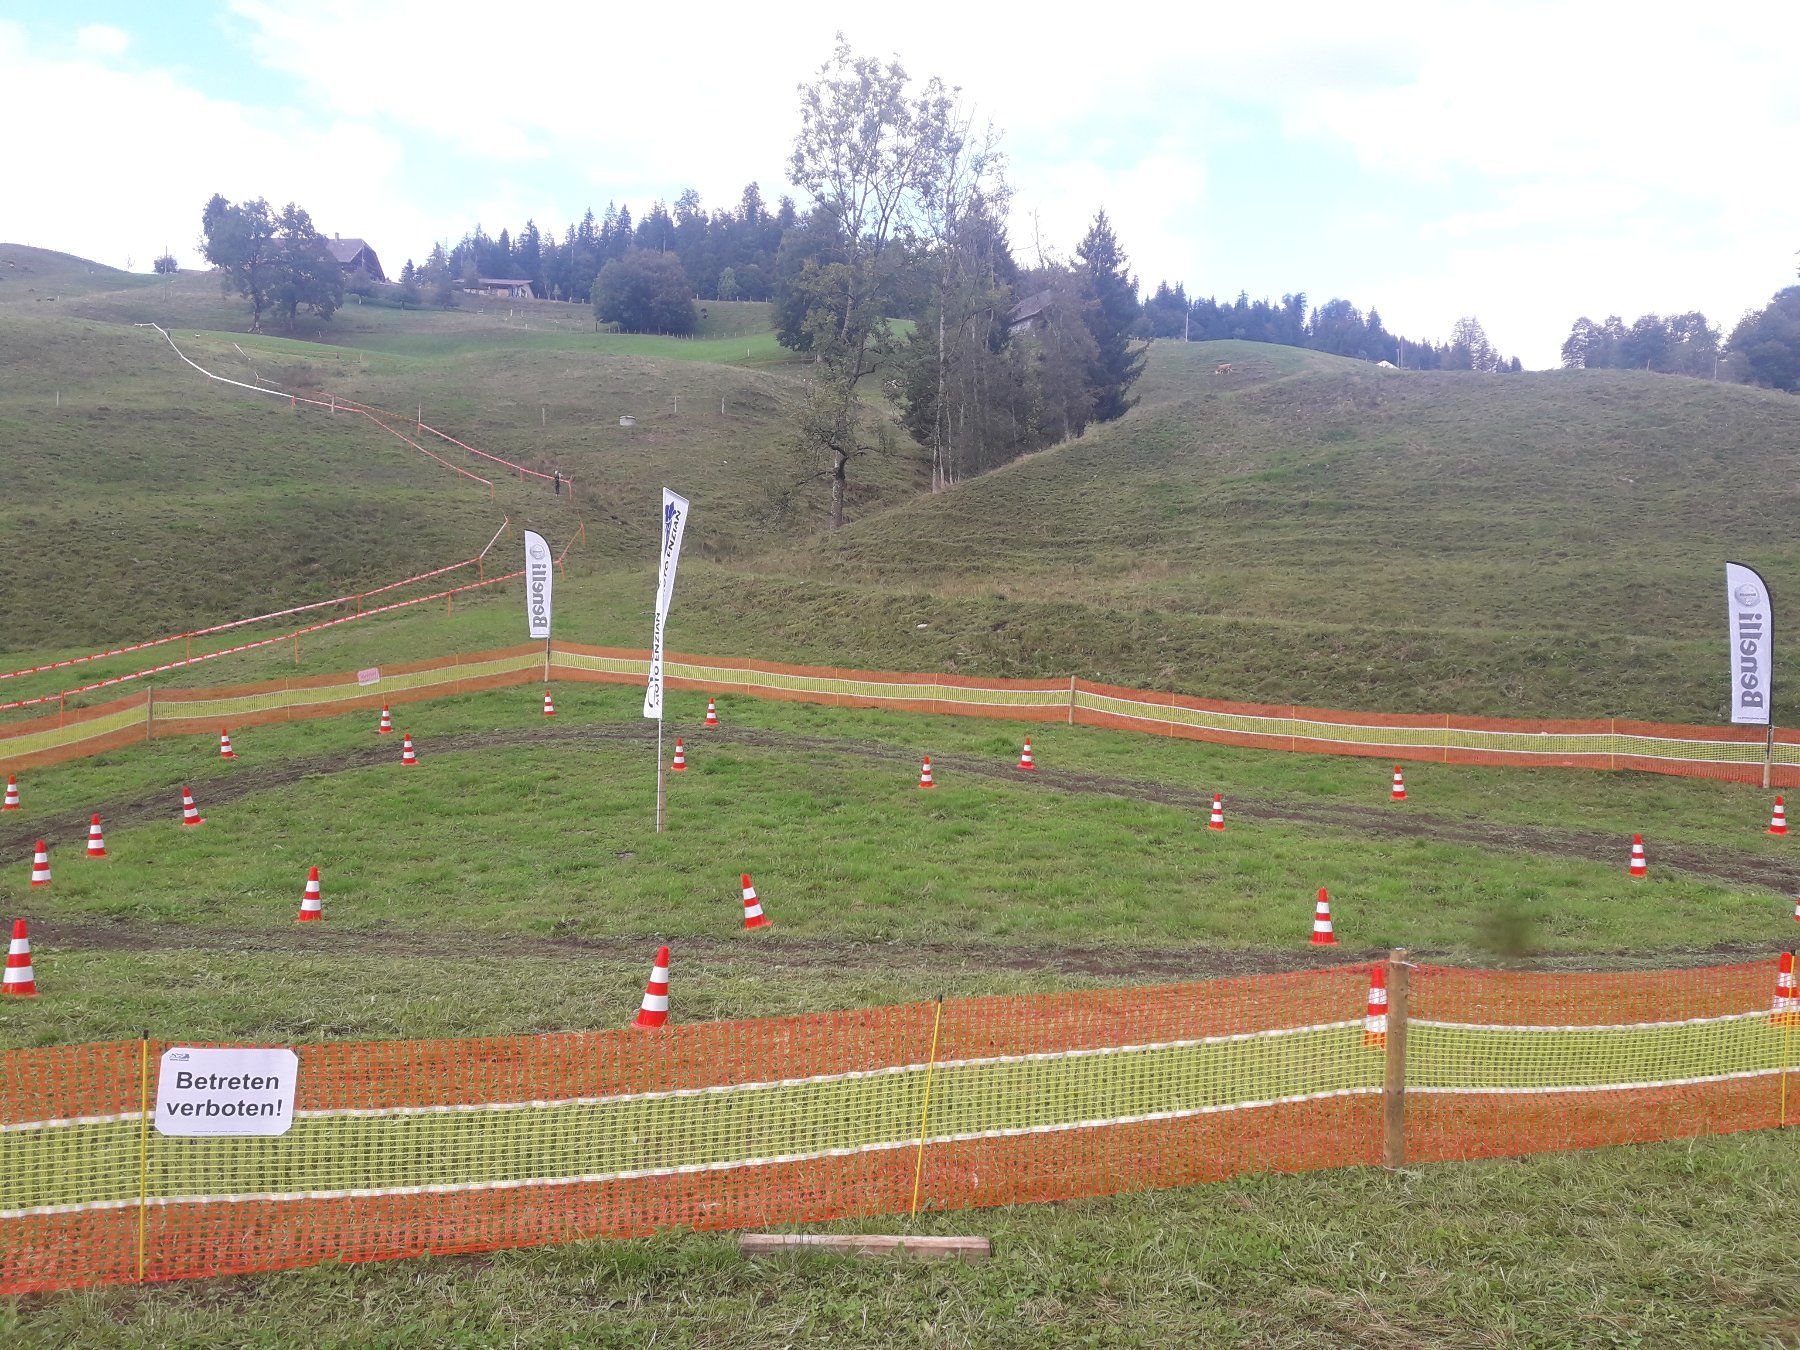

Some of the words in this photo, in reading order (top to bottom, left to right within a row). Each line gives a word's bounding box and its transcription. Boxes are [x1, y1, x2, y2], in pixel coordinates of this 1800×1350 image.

[653, 612, 661, 661] ENZIAN
[176, 1071, 279, 1090] Betreten
[167, 1099, 283, 1116] verboten!
